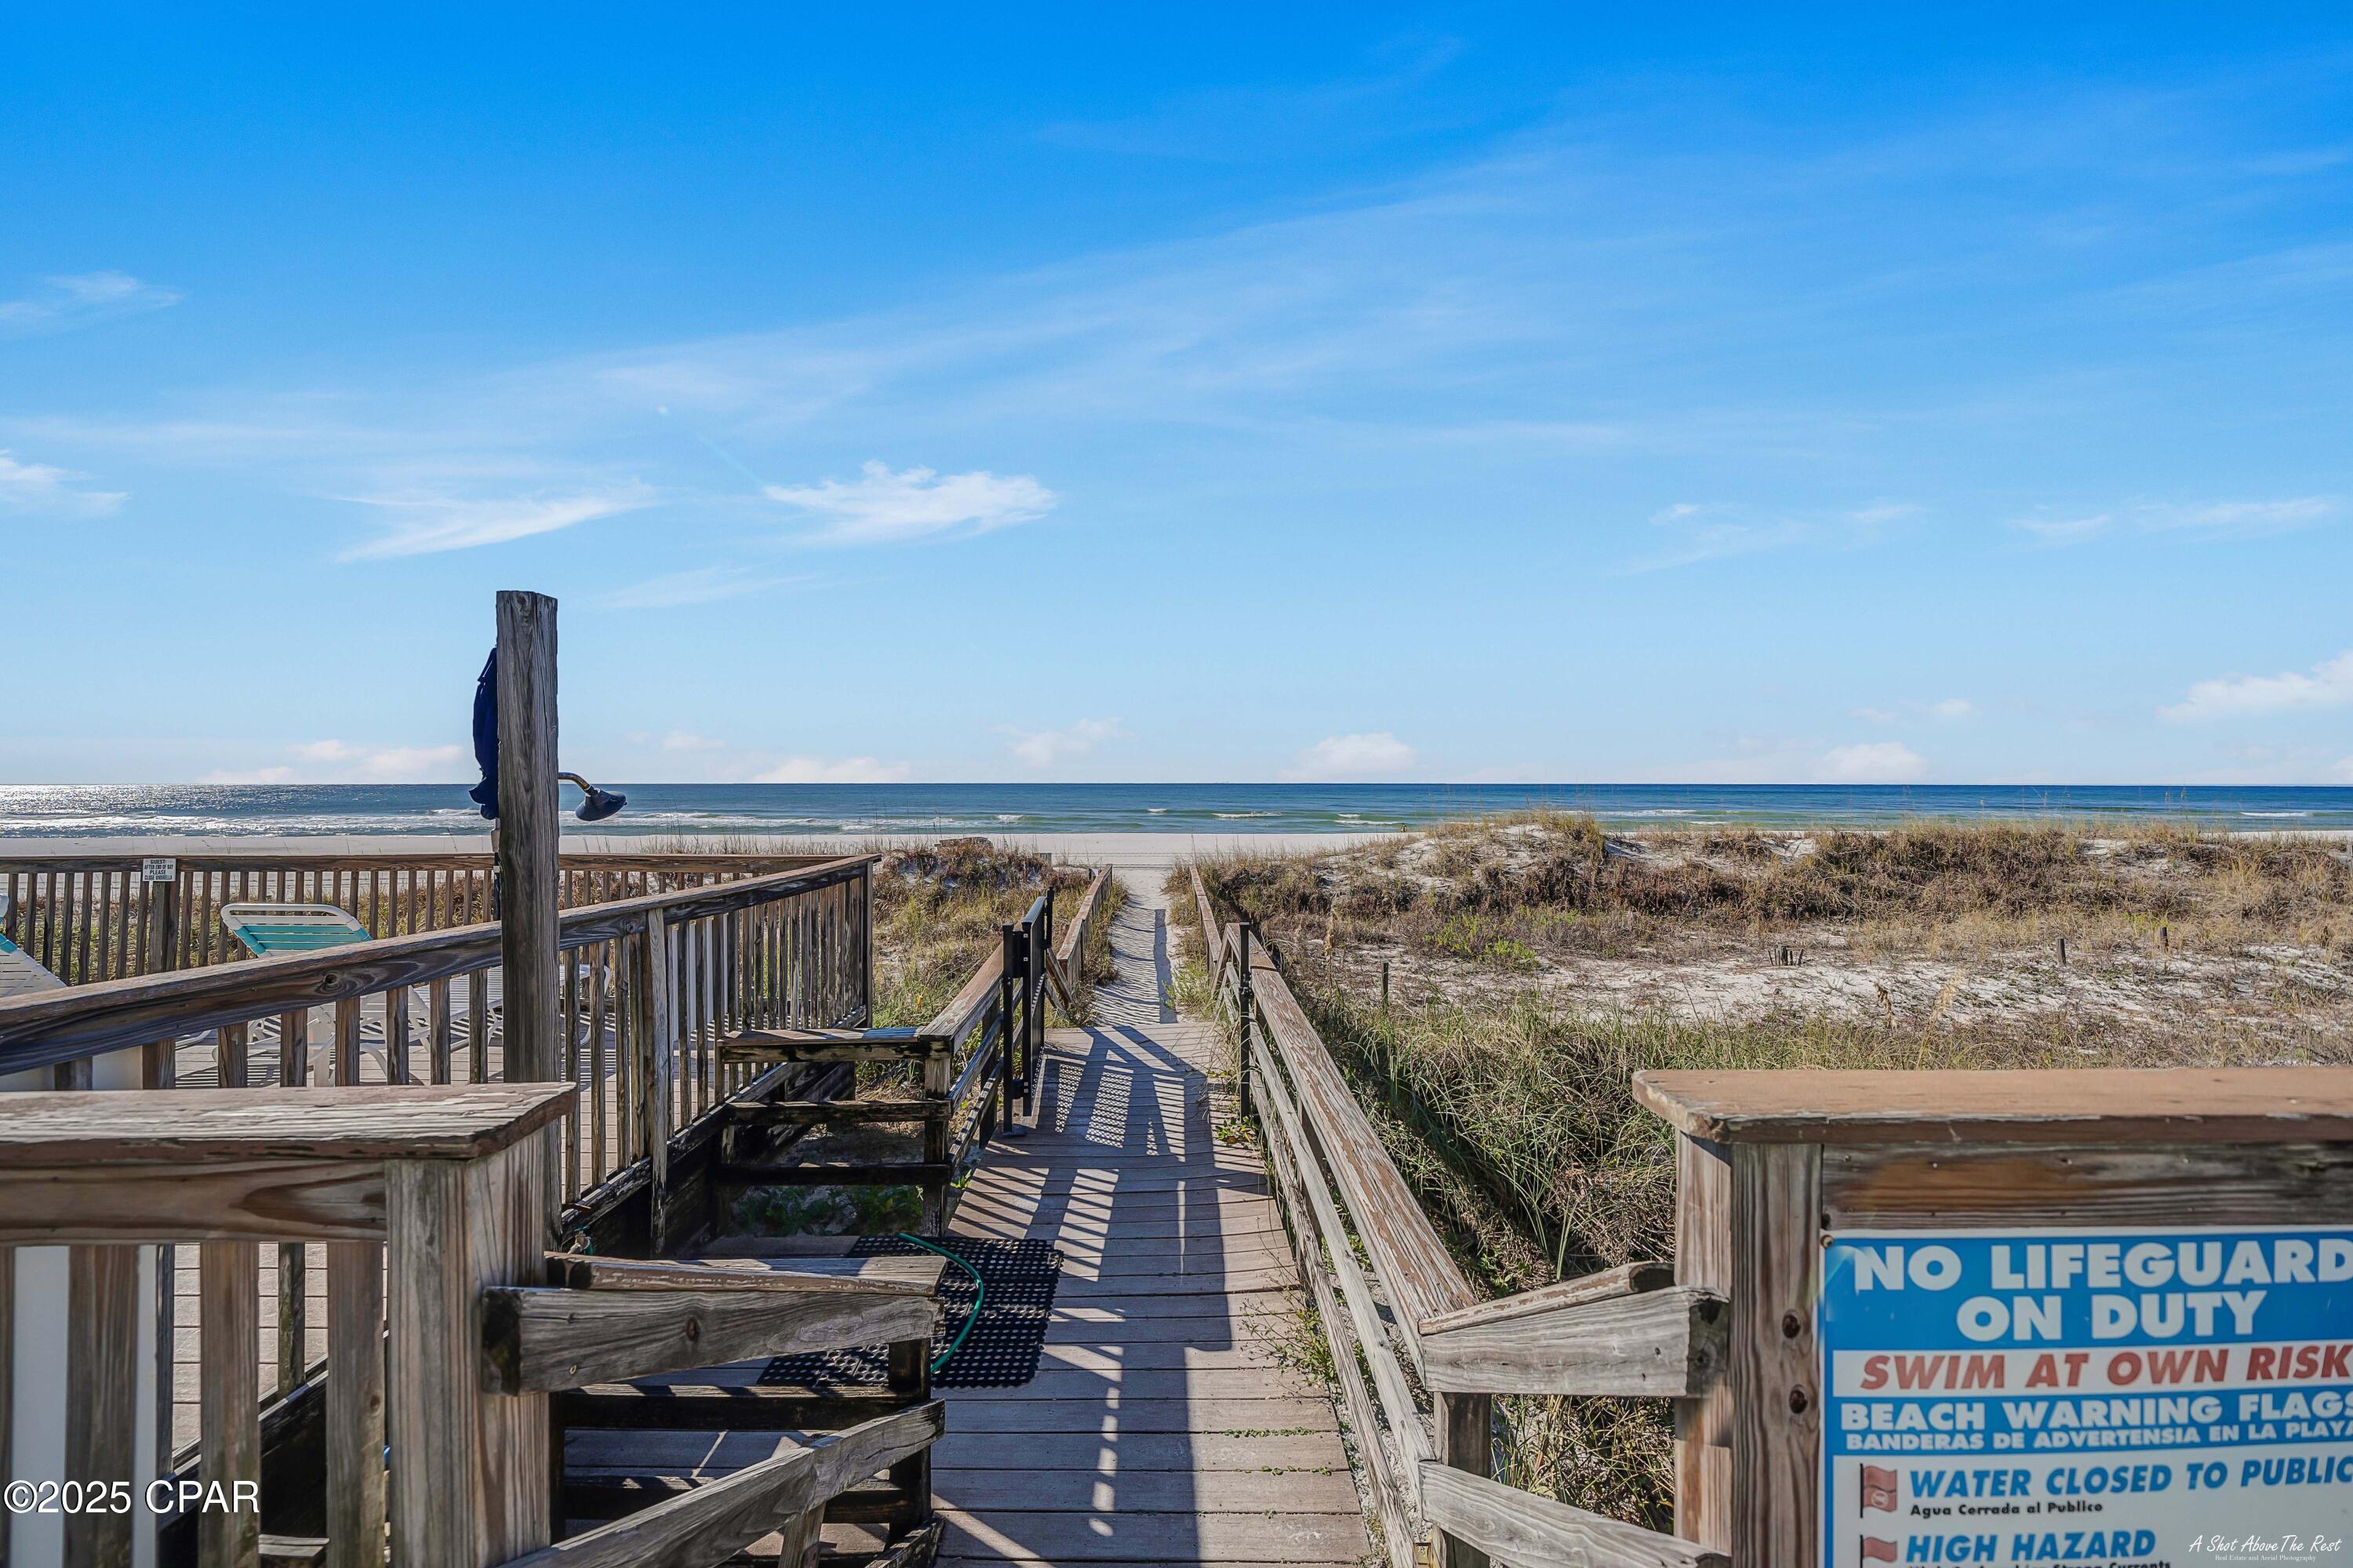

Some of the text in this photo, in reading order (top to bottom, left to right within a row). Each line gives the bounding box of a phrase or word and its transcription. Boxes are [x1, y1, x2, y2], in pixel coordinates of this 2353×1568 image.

[1853, 1239, 2353, 1291] NO LIFEGUARD
[1956, 1290, 2268, 1342] ON DUTY
[1860, 1344, 2353, 1390] SWIM AT OWN RISK
[1840, 1402, 1986, 1431] BEACH
[2002, 1395, 2223, 1429] WARNING
[1846, 1433, 1985, 1450] BANDERAS
[1993, 1432, 2025, 1450] DE
[2033, 1426, 2201, 1448] ADVERTENSIA
[2209, 1424, 2239, 1442] EN
[2248, 1423, 2277, 1440] LA
[1910, 1455, 2353, 1497] WATER CLOSED TO PUBLIC
[1910, 1501, 2103, 1519] Agua Cerrada al Publico
[1906, 1530, 2156, 1563] HIGH HAZARD
